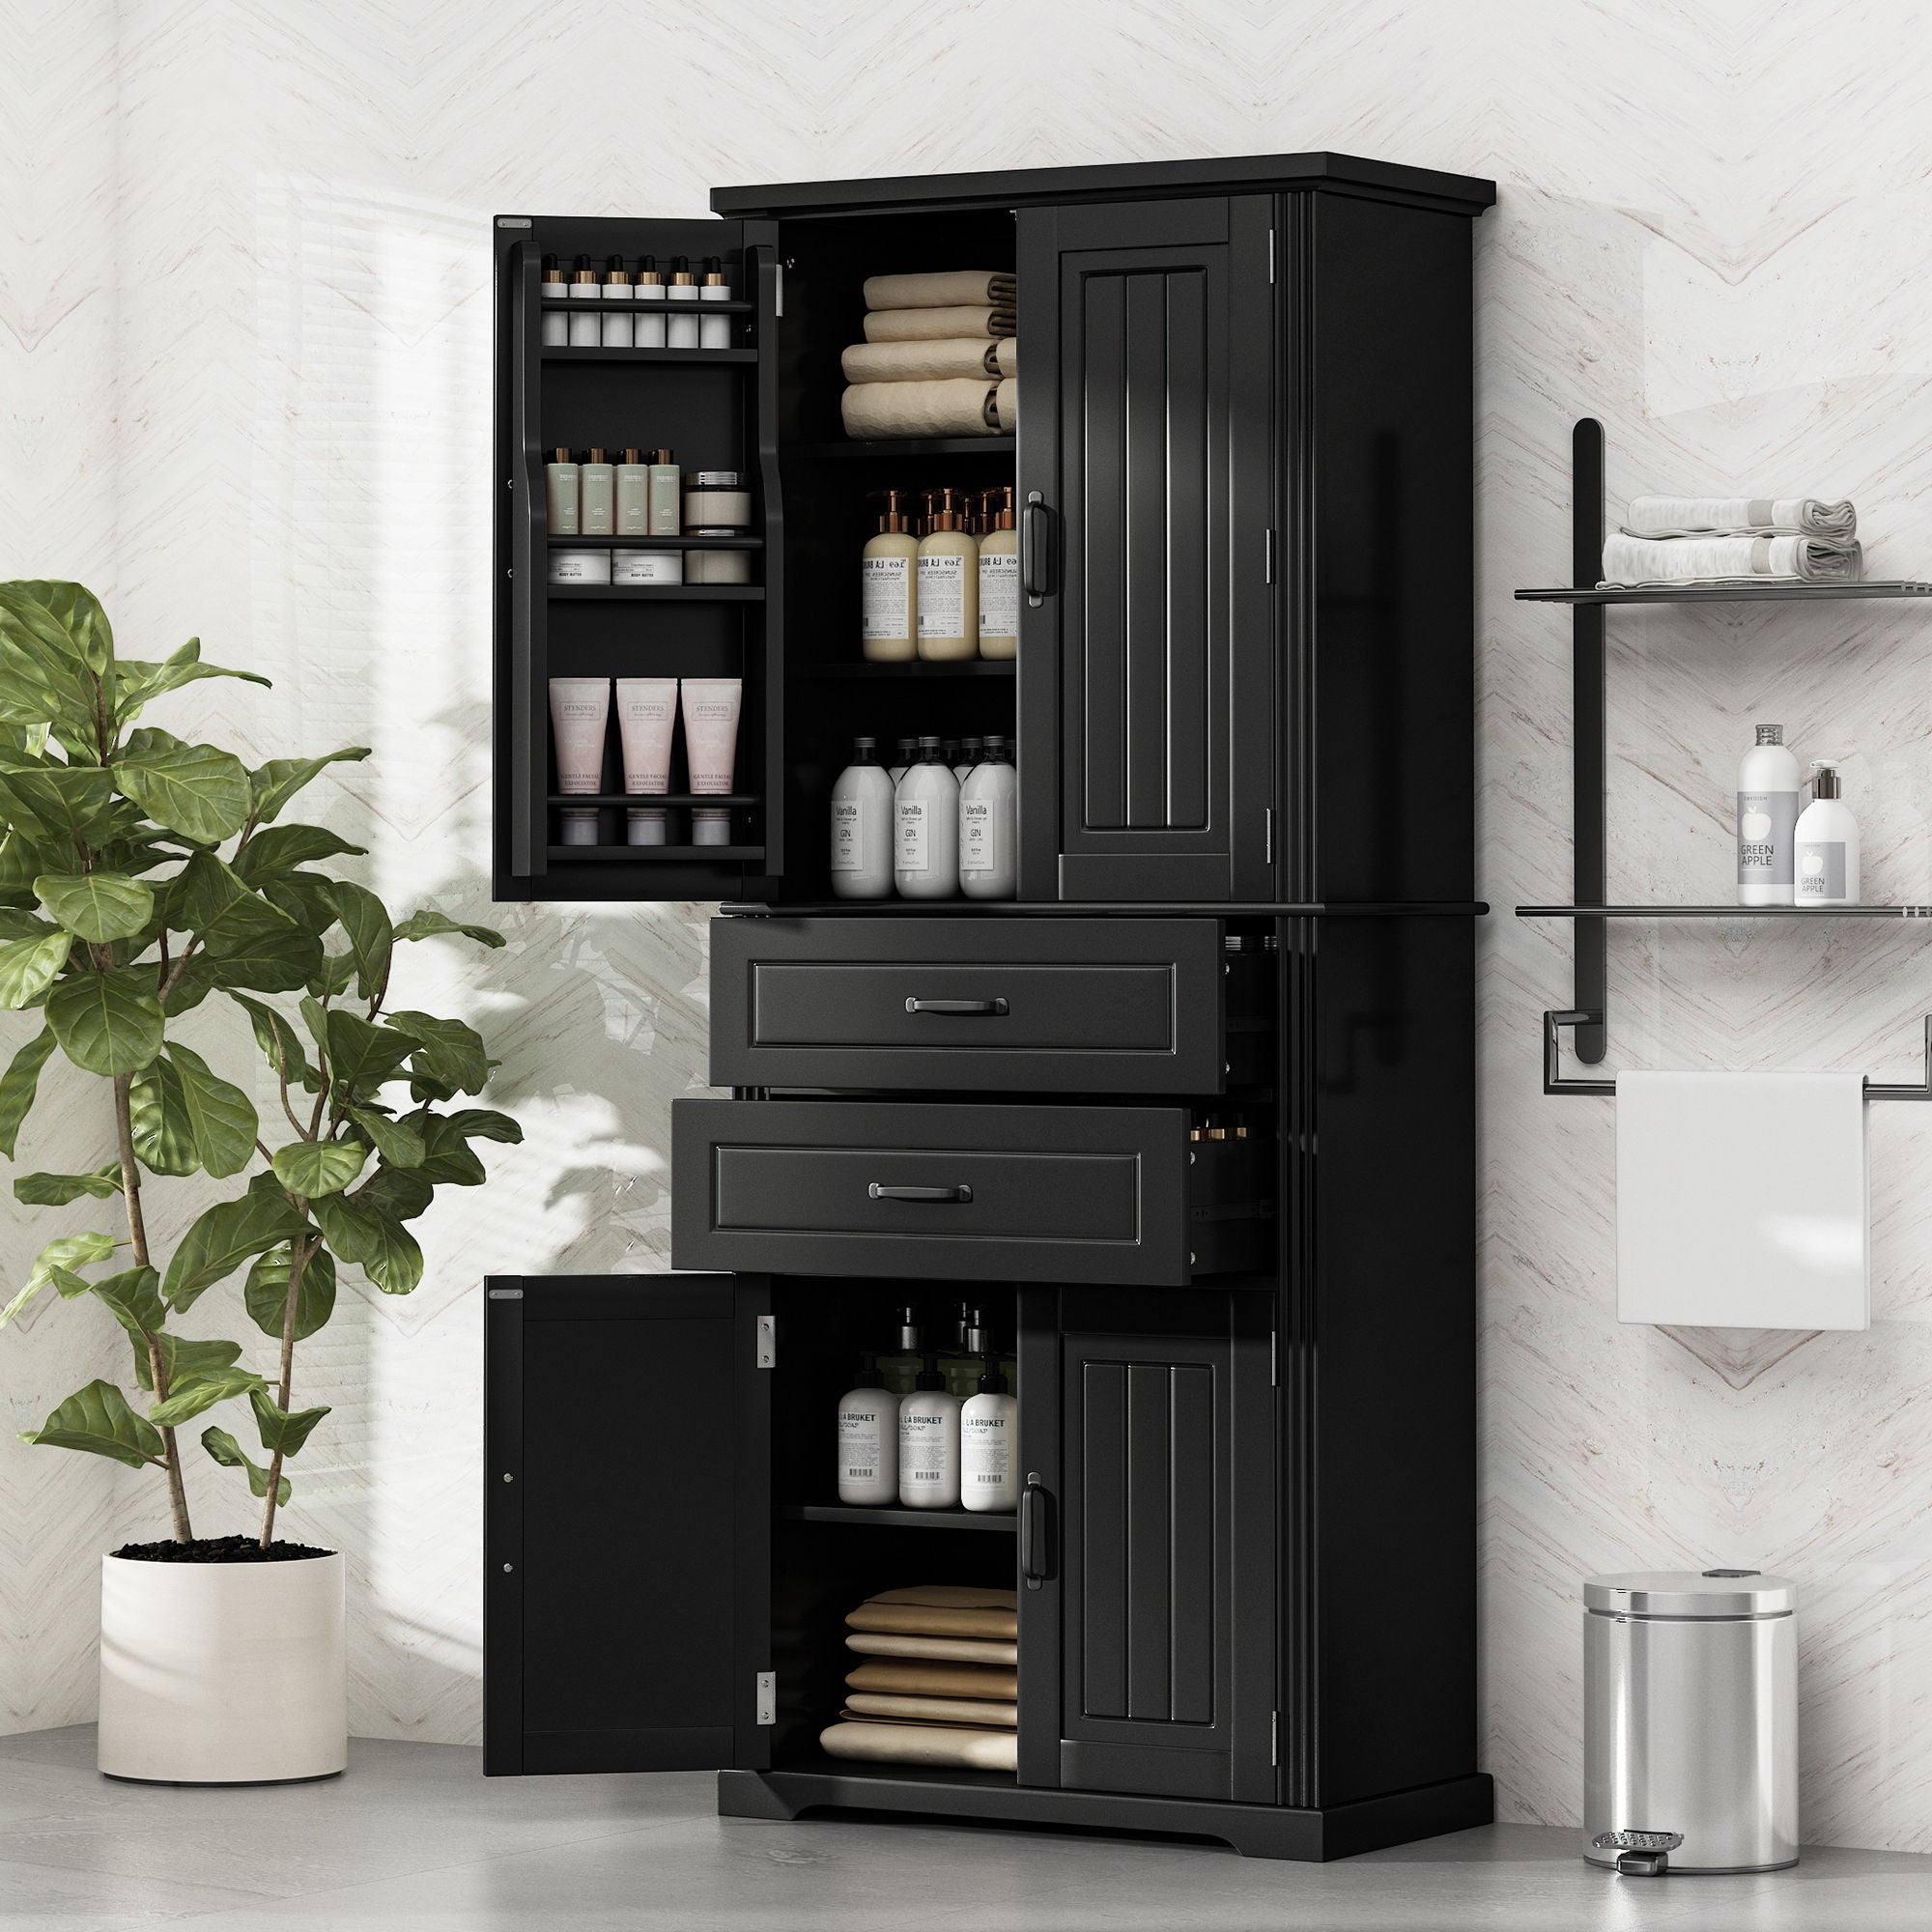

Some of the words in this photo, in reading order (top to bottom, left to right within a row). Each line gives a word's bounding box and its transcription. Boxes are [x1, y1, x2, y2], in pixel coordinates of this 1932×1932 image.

[836, 806, 857, 815] Vanilla
[901, 806, 923, 815] Vanilla
[966, 805, 987, 814] Vanilla
[840, 829, 851, 838] GIN
[905, 829, 916, 838] GIN
[970, 829, 981, 838] GIN
[1741, 844, 1774, 855] GREEN
[1742, 856, 1773, 866] APPLE
[847, 1413, 876, 1422] BRUKET
[975, 1419, 1005, 1428] BRUKET
